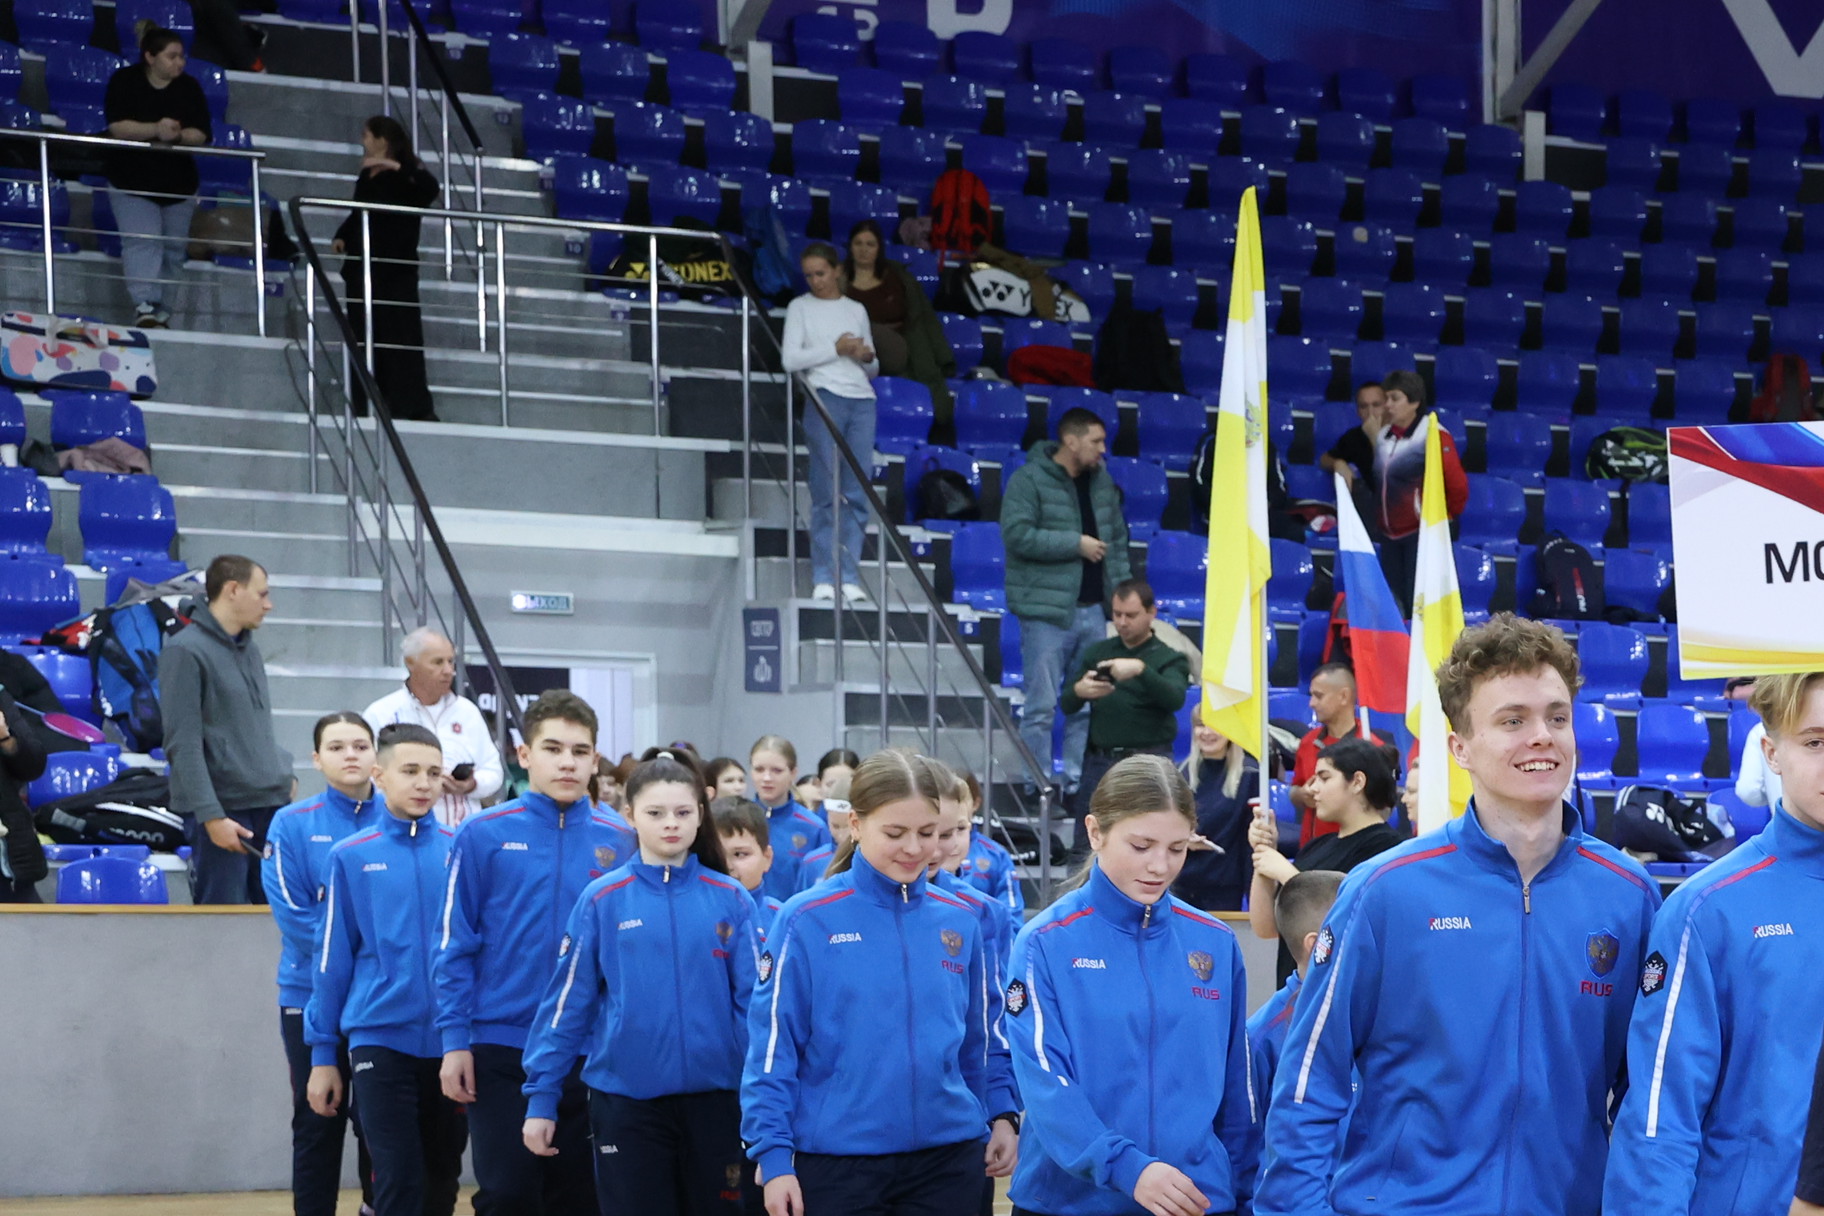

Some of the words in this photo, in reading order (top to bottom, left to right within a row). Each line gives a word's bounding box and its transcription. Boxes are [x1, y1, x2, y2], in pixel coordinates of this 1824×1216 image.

[1428, 916, 1473, 931] RUSSIA
[1753, 923, 1794, 939] RUSSIA
[828, 932, 862, 944] RUSSIA
[941, 960, 964, 975] RUS
[1072, 958, 1106, 970] RUSSIA
[1191, 987, 1220, 1001] RUS
[1581, 981, 1613, 997] RUS
